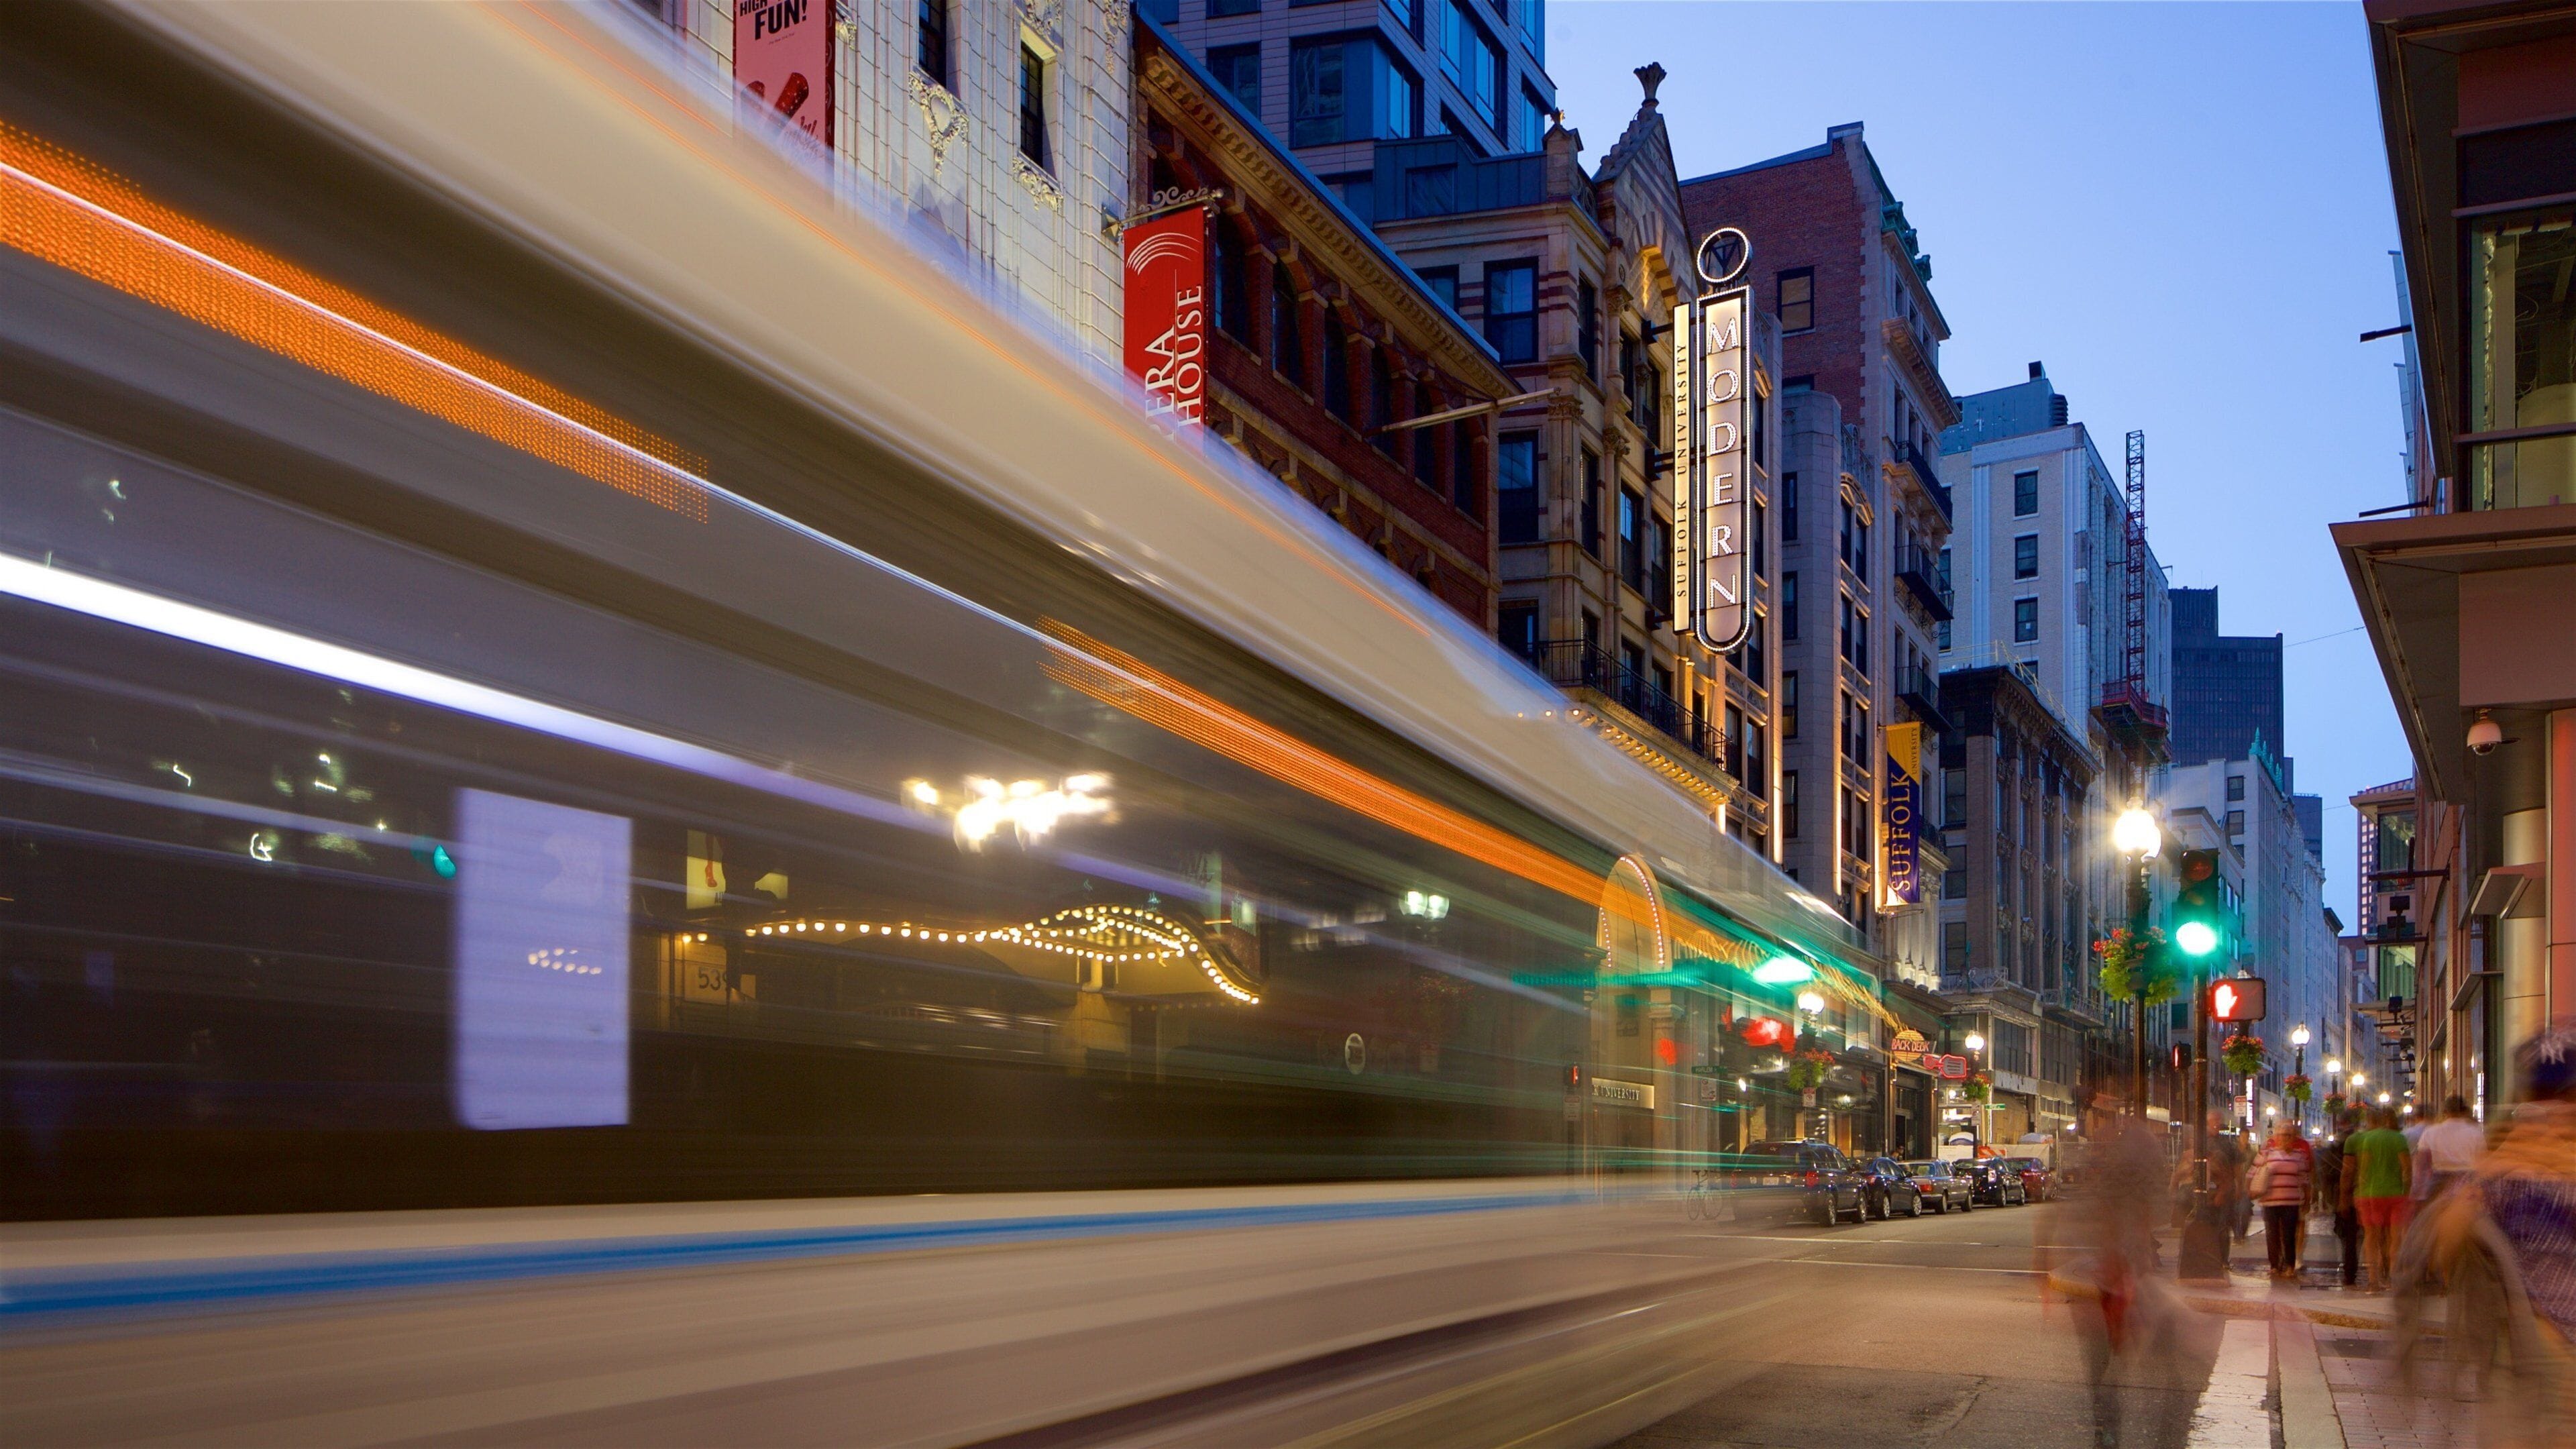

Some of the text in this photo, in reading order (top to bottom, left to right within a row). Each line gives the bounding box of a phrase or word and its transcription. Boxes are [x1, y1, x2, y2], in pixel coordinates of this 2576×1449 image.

[755, 0, 808, 40] FUN!
[1176, 285, 1202, 428] HOUSE
[1677, 344, 1687, 597] SUFFOLK UNIVERSITY
[1706, 317, 1739, 608] MODERN
[1890, 771, 1911, 892] SUFFOLK
[1600, 1085, 1640, 1101] UNIVERSITY
[1892, 1038, 1930, 1053] BACK DECK
